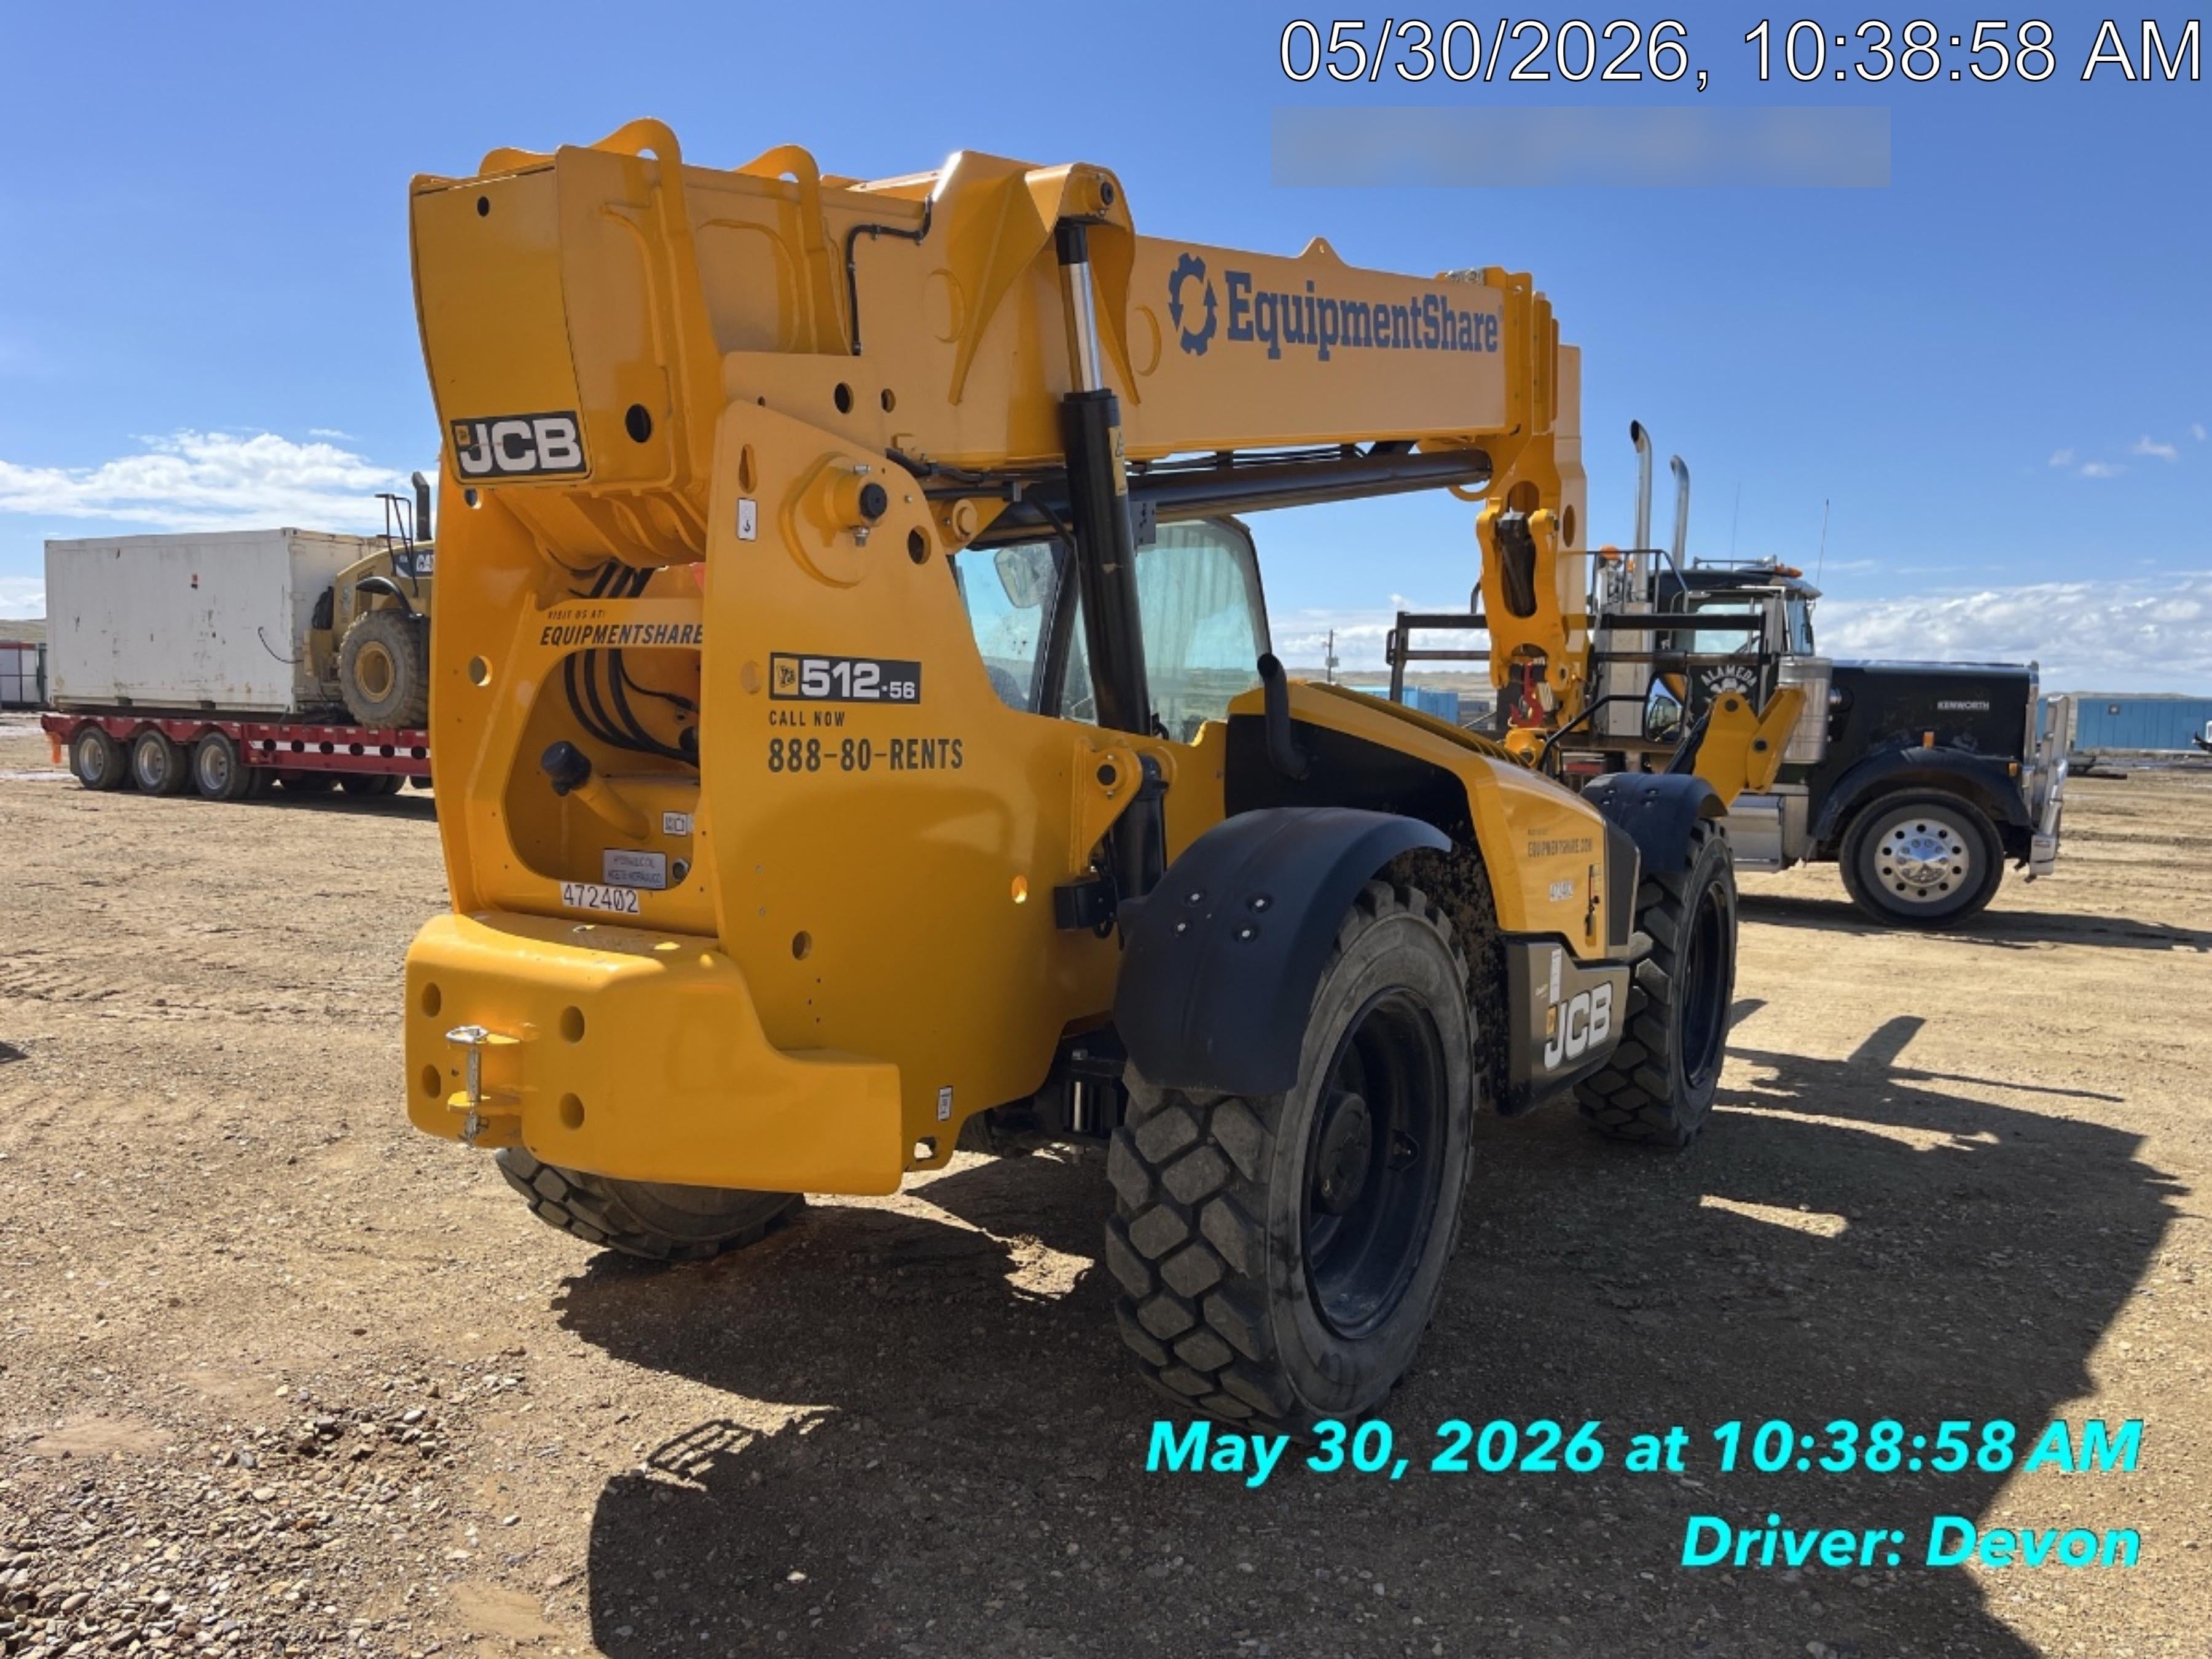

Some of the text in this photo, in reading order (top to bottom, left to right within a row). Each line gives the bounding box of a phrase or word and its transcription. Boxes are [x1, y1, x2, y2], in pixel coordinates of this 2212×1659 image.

[1225, 270, 1498, 361] EquipmentShare
[460, 417, 582, 473] JCB
[540, 624, 703, 646] EQUIPMENTSHARE
[1700, 664, 1757, 686] ALAMEDA
[769, 710, 845, 727] CALL NOW
[1936, 700, 1990, 711] KENWORTH
[769, 738, 963, 773] 888-80-RENTS
[563, 884, 638, 913] 472402
[1544, 982, 1612, 1070] JCB
